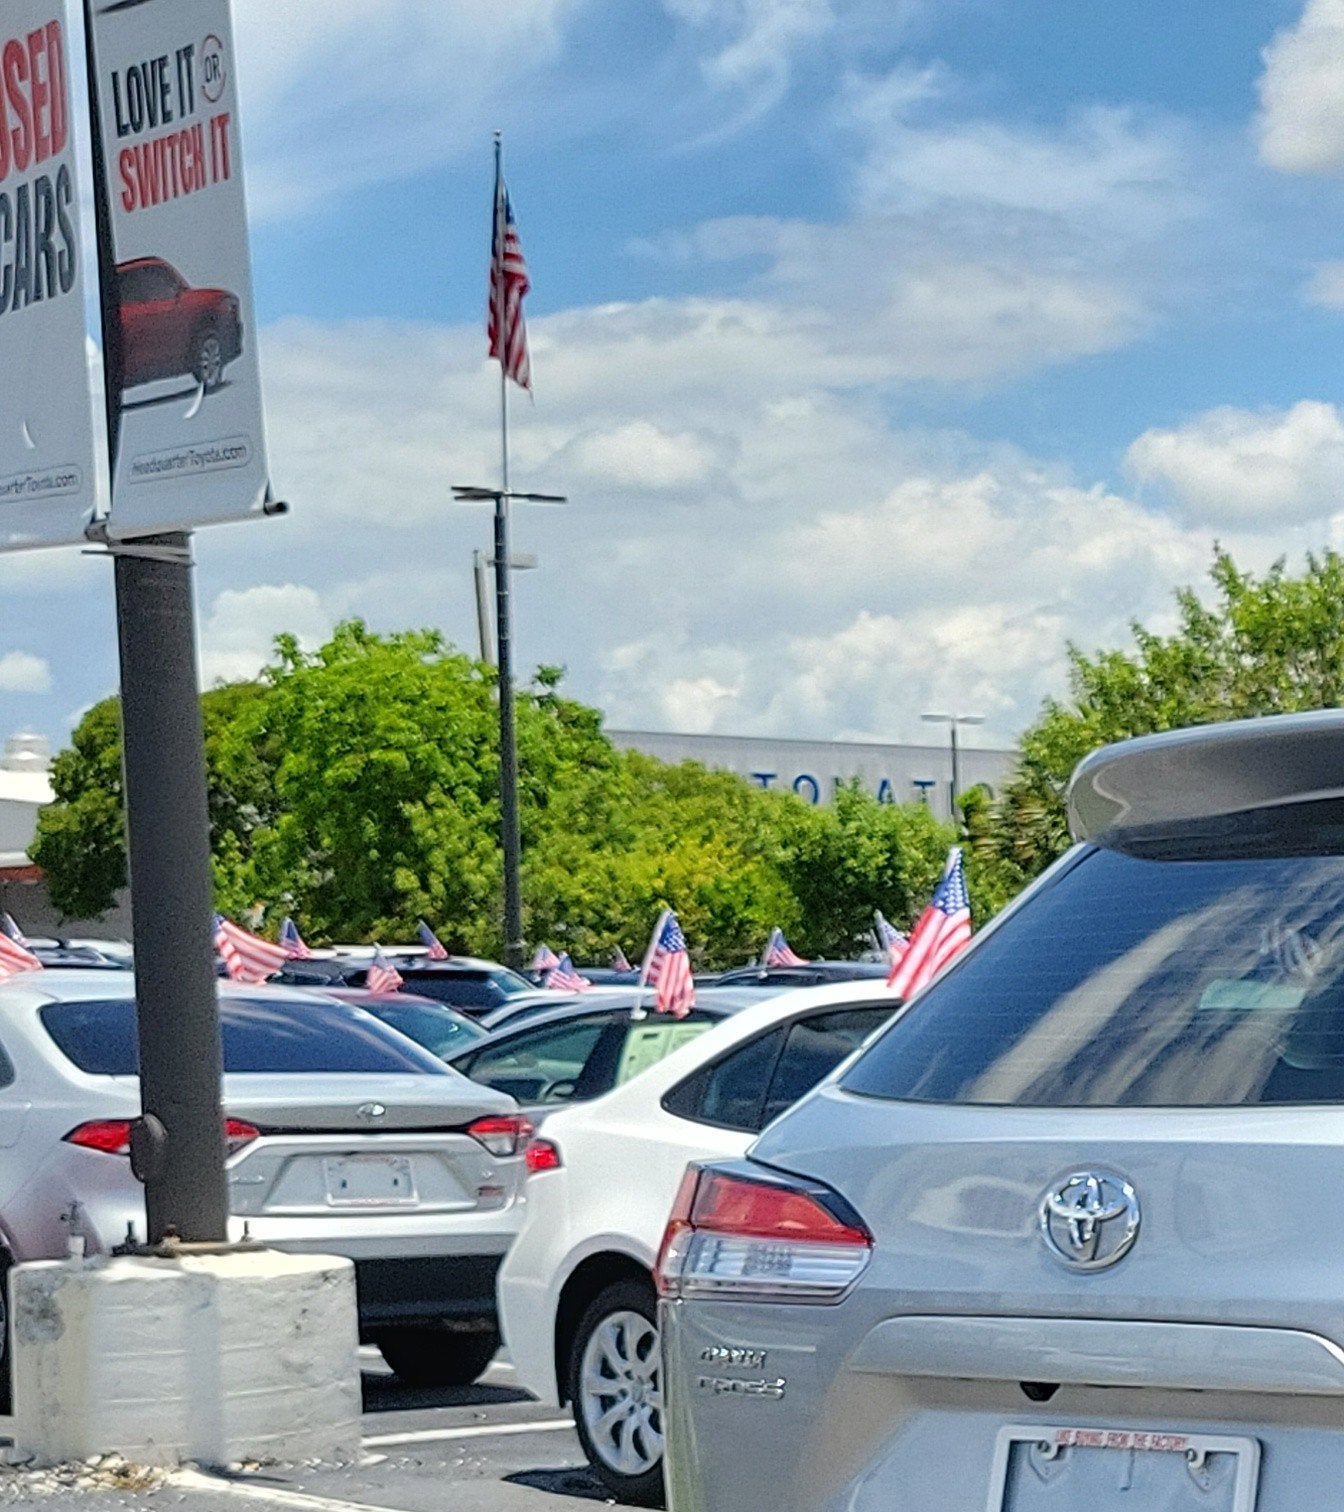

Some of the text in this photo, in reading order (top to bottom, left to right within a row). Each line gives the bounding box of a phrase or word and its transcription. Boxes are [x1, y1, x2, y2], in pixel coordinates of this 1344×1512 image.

[111, 43, 222, 139] LOVE IT OR
[119, 112, 231, 213] SWITCH IT
